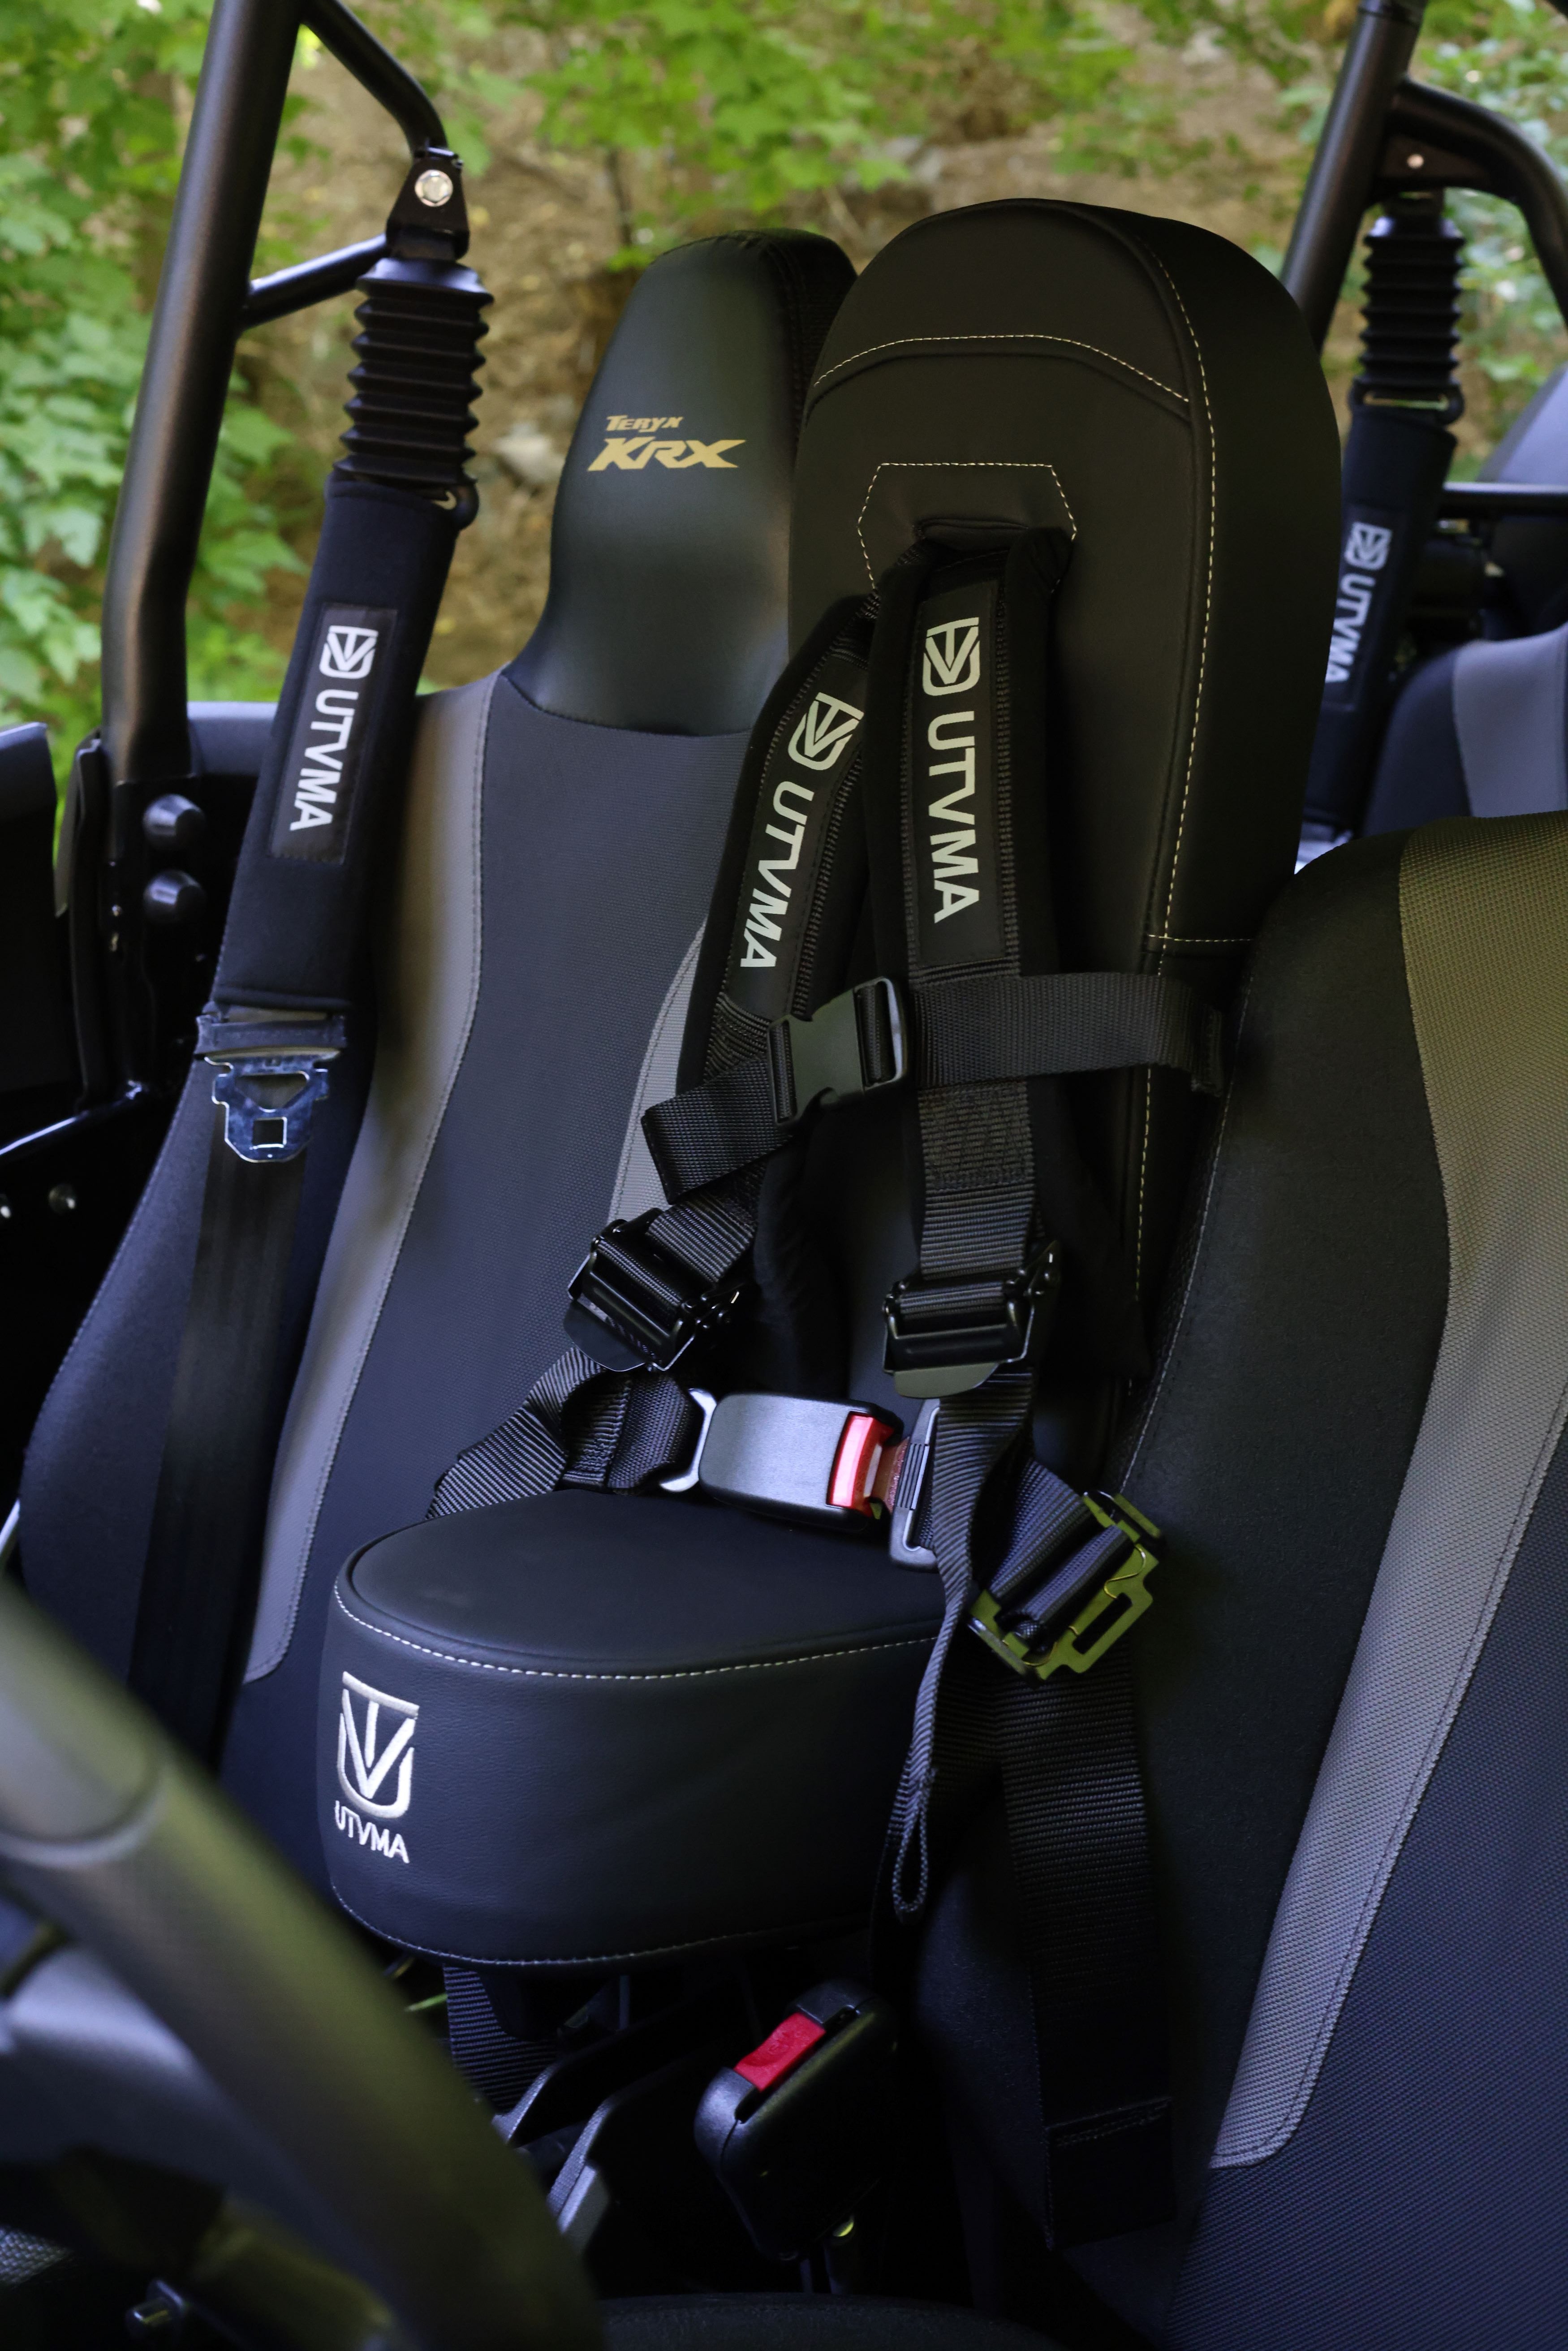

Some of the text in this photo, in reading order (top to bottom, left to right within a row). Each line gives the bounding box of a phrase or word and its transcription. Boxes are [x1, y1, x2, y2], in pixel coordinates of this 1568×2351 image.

[587, 436, 746, 471] KRX
[289, 690, 359, 831] UTVMA
[928, 711, 980, 923] UTVMA
[740, 781, 814, 967] UTVMA
[334, 1800, 410, 1864] UTVMA
